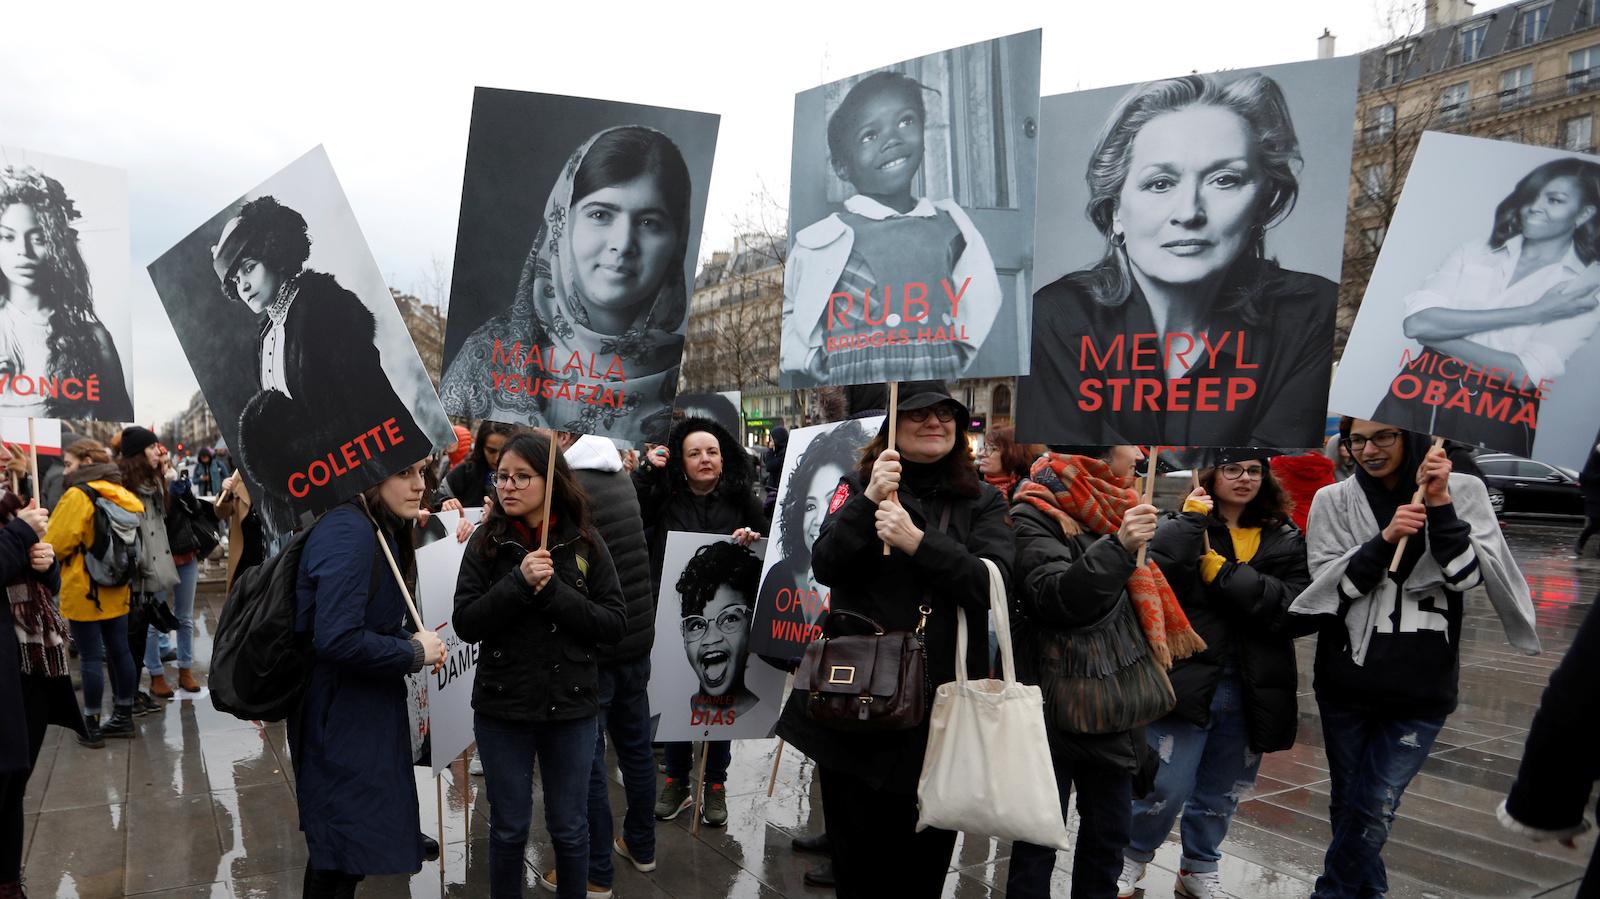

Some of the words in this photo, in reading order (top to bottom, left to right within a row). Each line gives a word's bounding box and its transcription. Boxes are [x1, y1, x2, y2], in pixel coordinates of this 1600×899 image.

[827, 277, 972, 331] RUBY
[827, 330, 912, 353] BRIDGES
[917, 324, 970, 343] HALL
[1079, 330, 1259, 372] MERYL
[491, 339, 626, 382] MALALA
[1399, 348, 1555, 401] MICHELLE
[0, 373, 100, 401] YONCÉ
[491, 371, 625, 409] YOUSAFZAI
[1077, 377, 1257, 412] STREEP
[1391, 374, 1537, 429] OBAMA
[288, 417, 404, 498] COLETTE
[776, 588, 831, 616] OPRA
[772, 620, 823, 643] WINFR
[690, 707, 736, 726] DIAS
